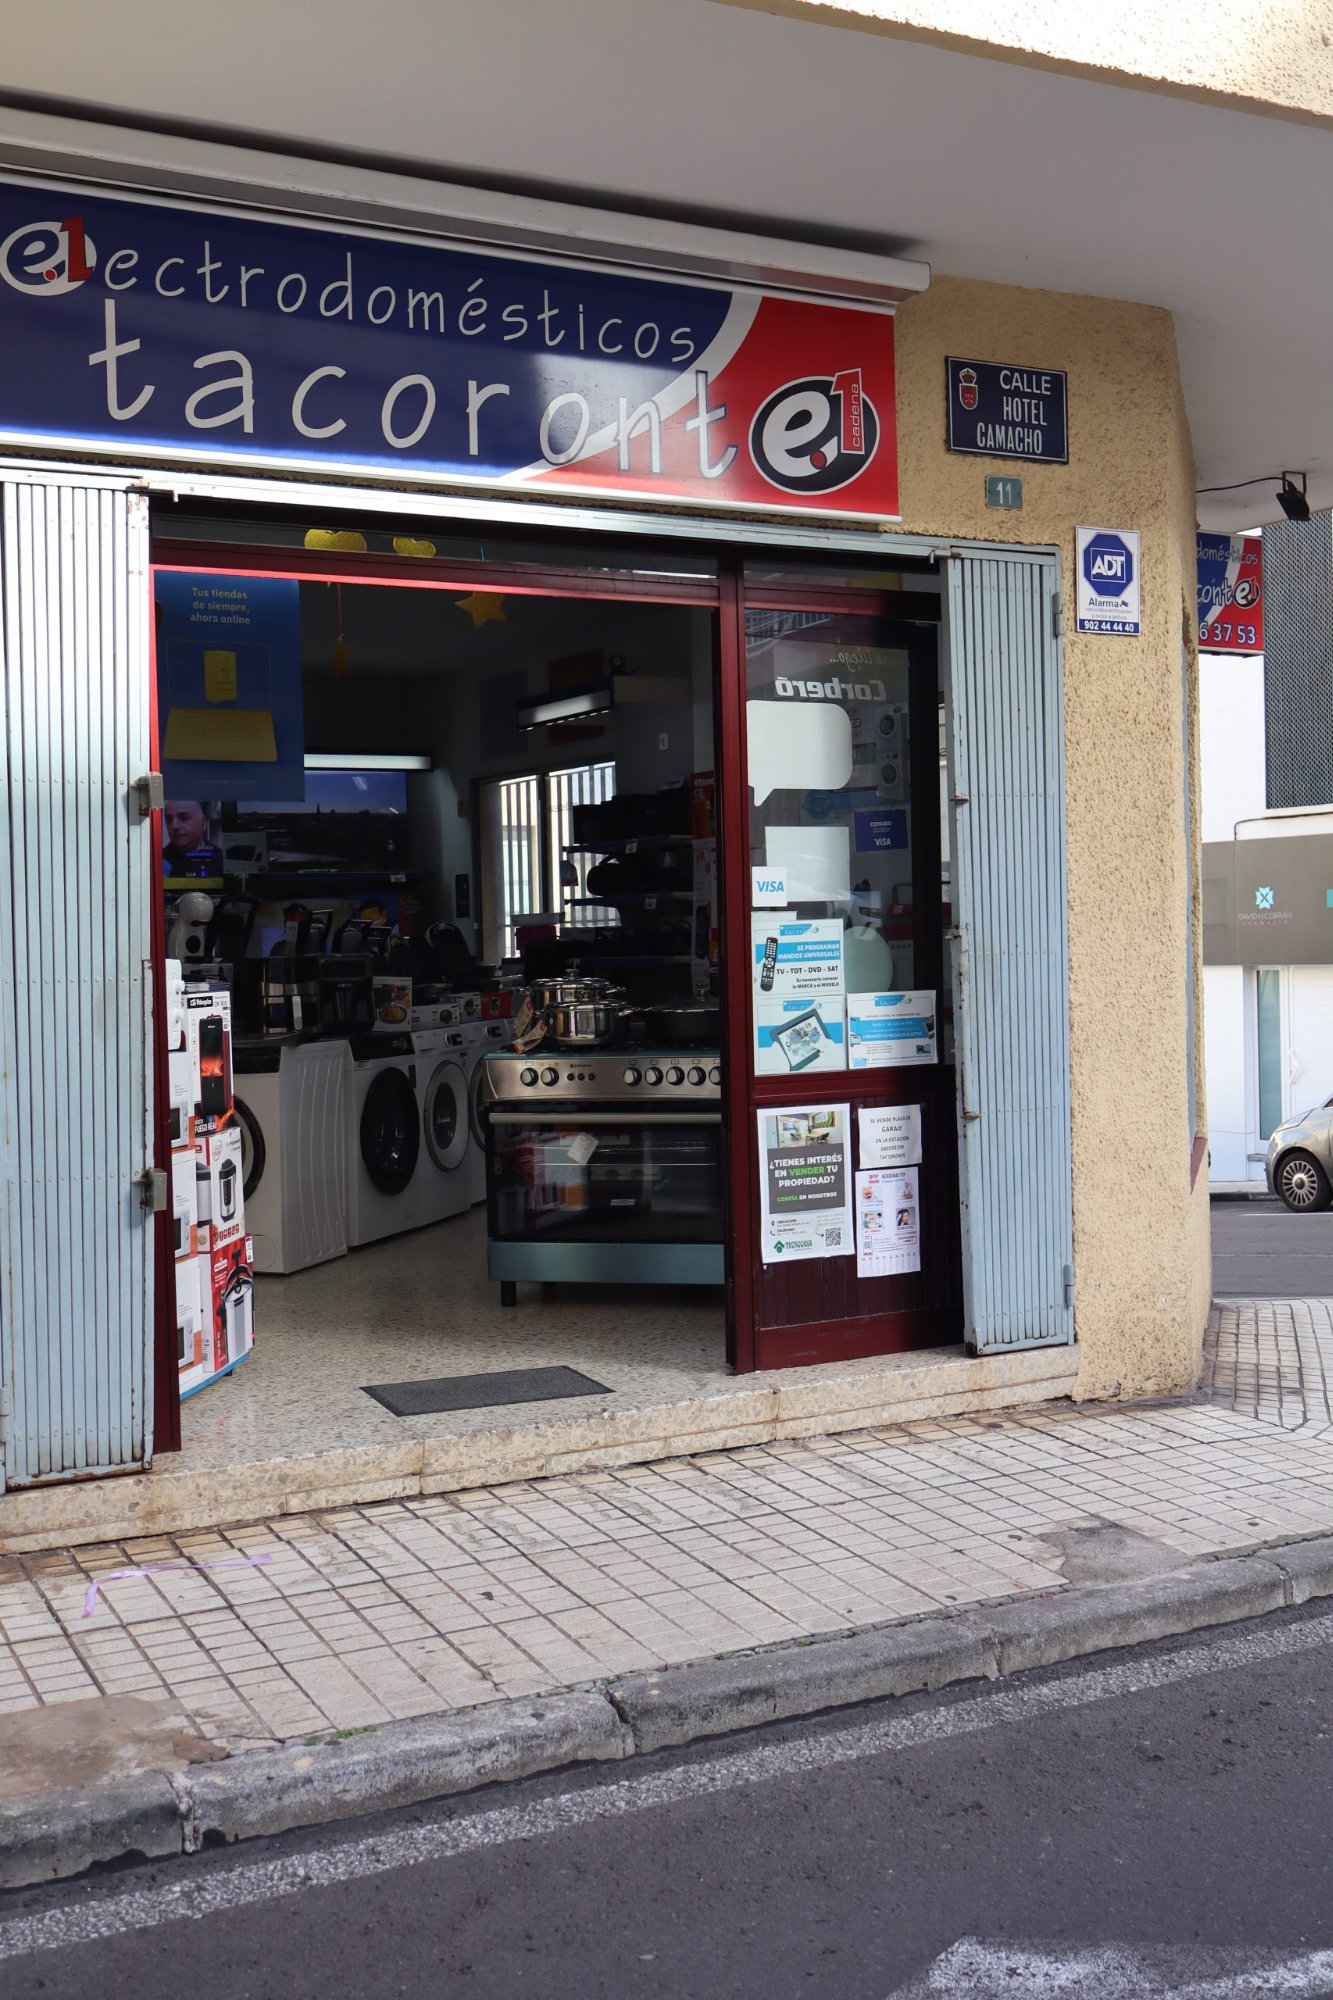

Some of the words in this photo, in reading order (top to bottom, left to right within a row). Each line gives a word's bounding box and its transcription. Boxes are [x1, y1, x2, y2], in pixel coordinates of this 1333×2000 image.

[1000, 369, 1051, 395] CALLE
[850, 383, 860, 447] cadena
[1003, 396, 1047, 426] HOTEL
[976, 422, 1043, 454] CAMACHO
[996, 481, 1012, 505] 11
[1092, 554, 1125, 577] ADT
[192, 587, 209, 597] Tus
[211, 588, 248, 599] tiendas
[193, 600, 205, 610] de
[208, 601, 250, 613] siempre,
[1088, 597, 1119, 608] Alarma
[190, 612, 218, 623] ahora
[220, 614, 251, 625] online
[1084, 620, 1099, 630] 902
[1101, 621, 1111, 631] 44
[1113, 622, 1123, 632] 44
[1124, 623, 1134, 632] 40
[1213, 623, 1232, 642] 37
[1237, 625, 1256, 644] 53
[874, 837, 891, 846] VISA
[755, 880, 784, 892] VISA
[1238, 912, 1258, 920] DAVID
[769, 1157, 805, 1169] ¿TIENES
[807, 1152, 843, 1165] INTERÉS
[774, 1169, 787, 1177] EN
[788, 1166, 825, 1176] VENDER
[826, 1164, 838, 1173] TU
[778, 1175, 835, 1188] PROPIEDAD?
[807, 1191, 837, 1199] NOSOTROS
